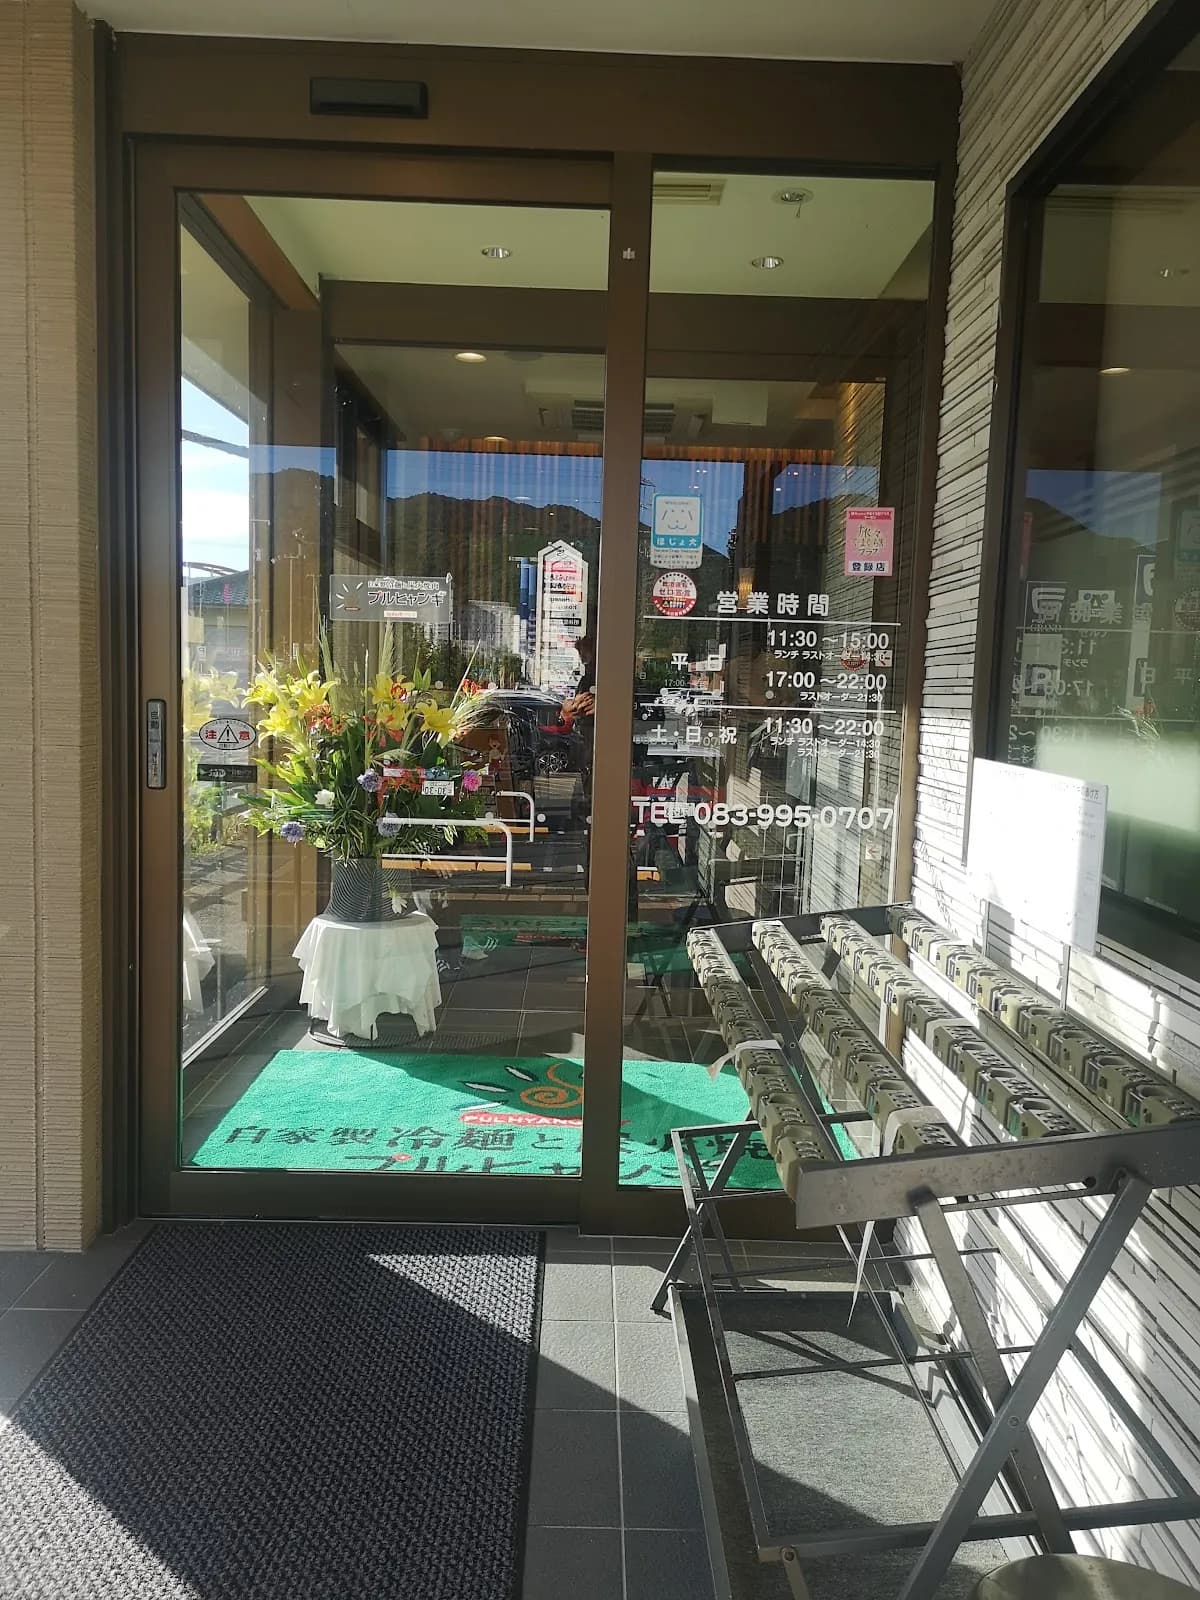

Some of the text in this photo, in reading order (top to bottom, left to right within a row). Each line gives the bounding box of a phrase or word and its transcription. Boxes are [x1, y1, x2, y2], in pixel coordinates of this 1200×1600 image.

[367, 590, 447, 607] プルヒャンギ
[716, 590, 829, 616] 営業時間
[767, 629, 817, 648] 11:30
[774, 650, 800, 660] ランチ
[766, 670, 816, 689] 17:00
[800, 691, 883, 703] ラストオーダー21:30
[651, 724, 737, 744] 土・日・祝
[765, 717, 813, 734] 11:30
[632, 801, 688, 824] TEL
[694, 802, 895, 830] 083-995-0707
